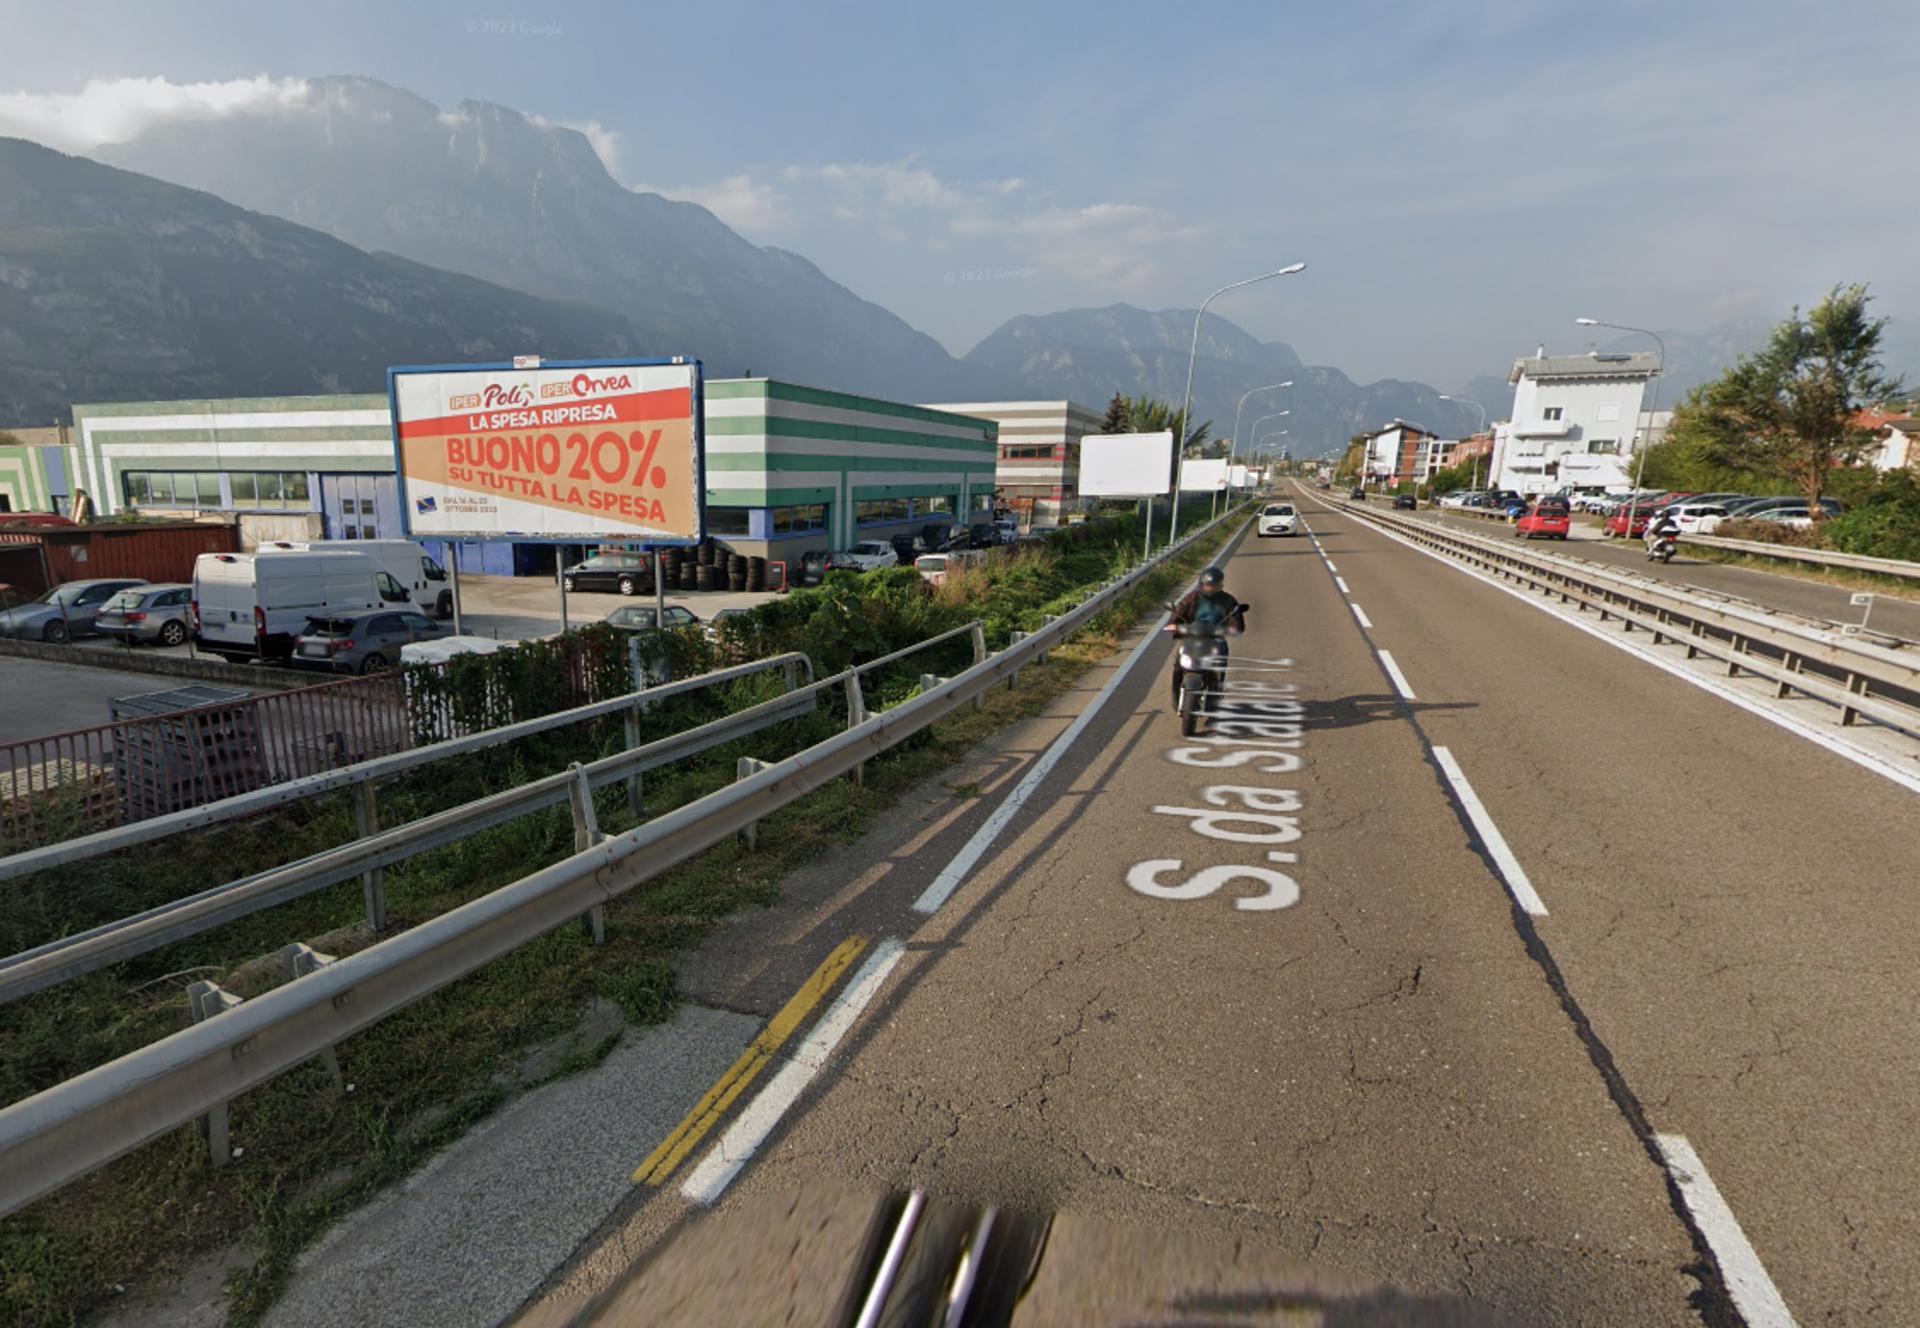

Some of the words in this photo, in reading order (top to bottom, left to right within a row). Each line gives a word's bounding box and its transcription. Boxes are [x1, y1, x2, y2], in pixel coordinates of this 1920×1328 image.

[450, 395, 480, 410] IPER
[541, 382, 573, 398] IPER
[571, 373, 632, 397] Orvea
[470, 414, 489, 430] LA
[491, 410, 540, 429] SPESA
[542, 402, 618, 424] RIPRESA
[447, 434, 560, 475] BUONO
[566, 429, 666, 489] 20%
[448, 467, 473, 482] SU
[477, 471, 546, 498] TUTTA
[552, 483, 584, 506] LA
[588, 490, 666, 523] SPESA
